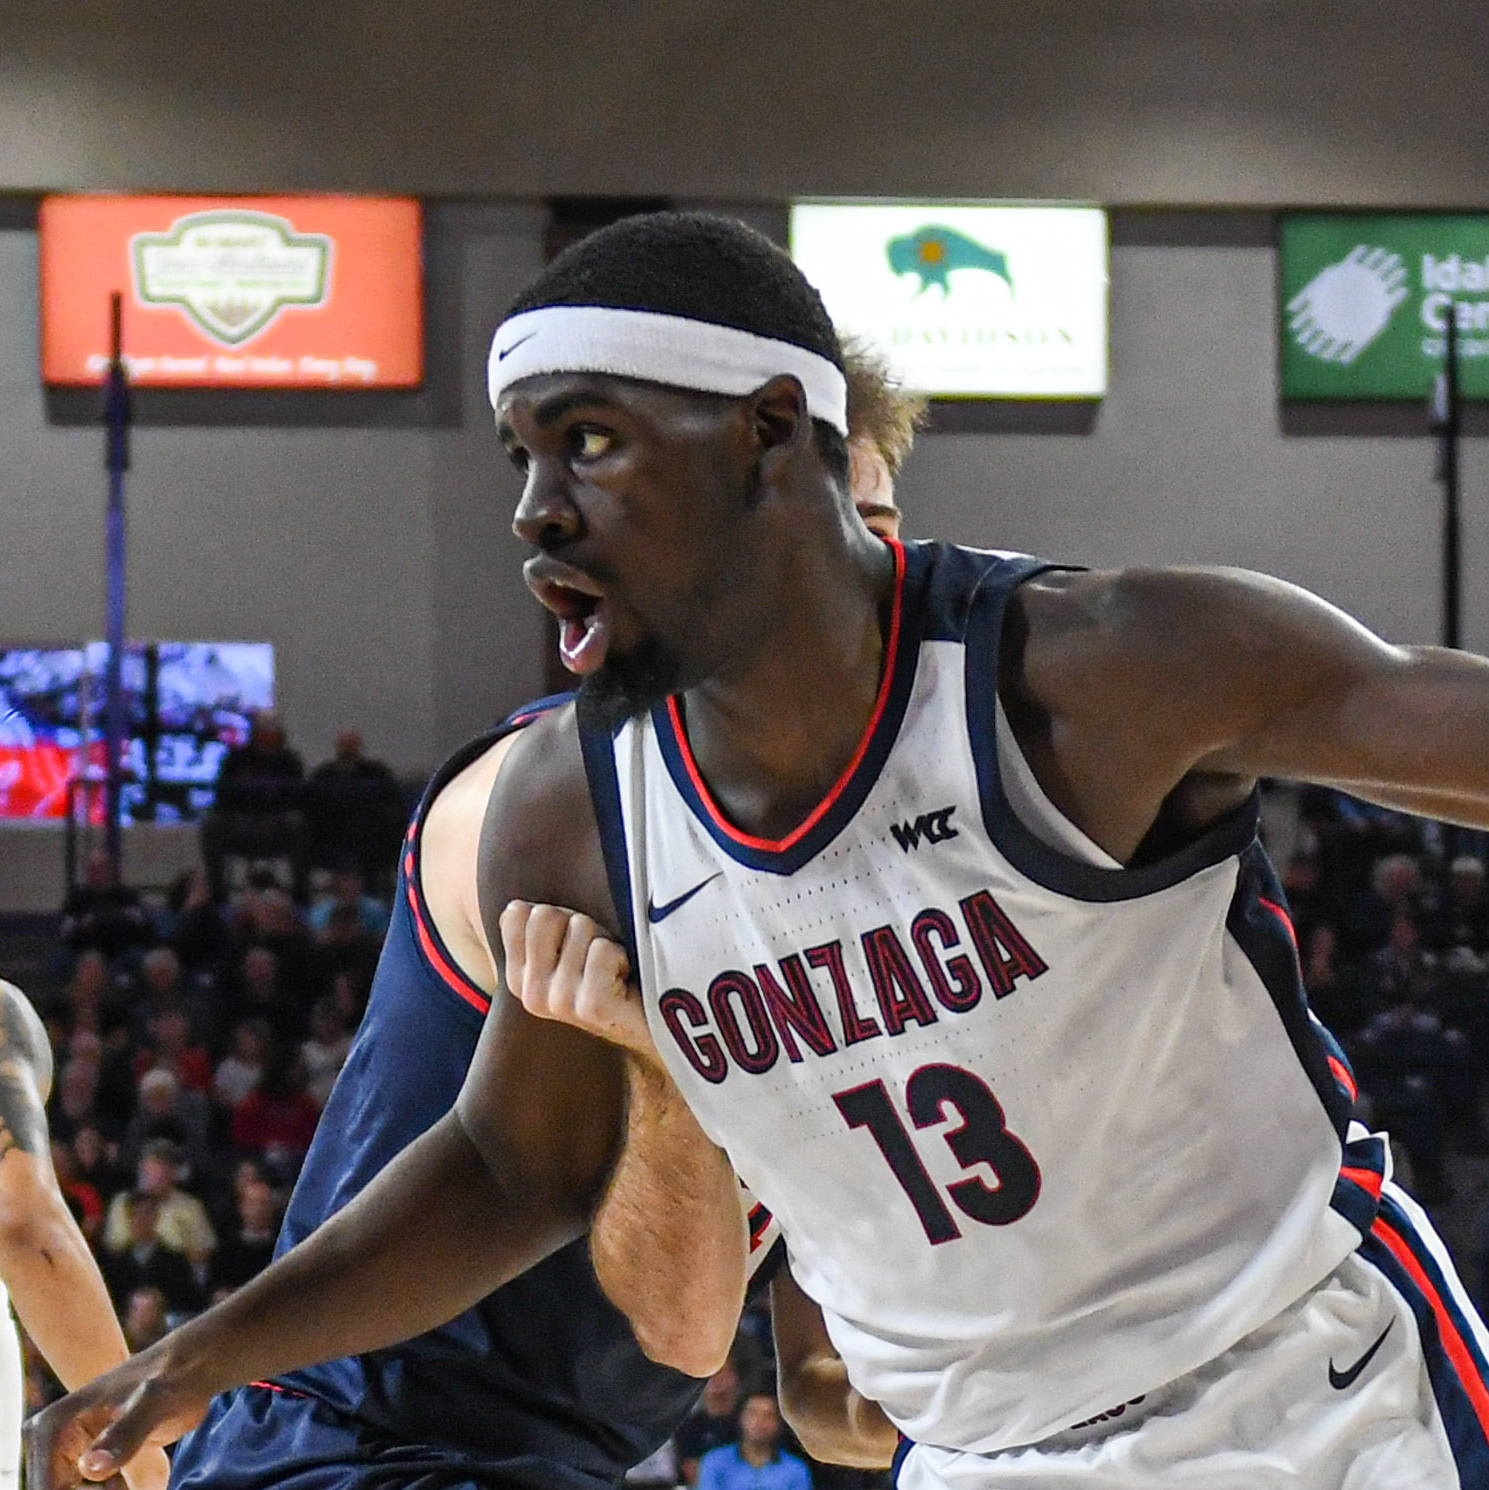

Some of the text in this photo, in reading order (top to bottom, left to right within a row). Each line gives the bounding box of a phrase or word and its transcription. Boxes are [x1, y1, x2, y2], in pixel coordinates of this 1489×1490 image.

[890, 805, 961, 853] WCC
[658, 889, 1049, 1084] GONZAGA
[833, 1063, 1042, 1245] 13
